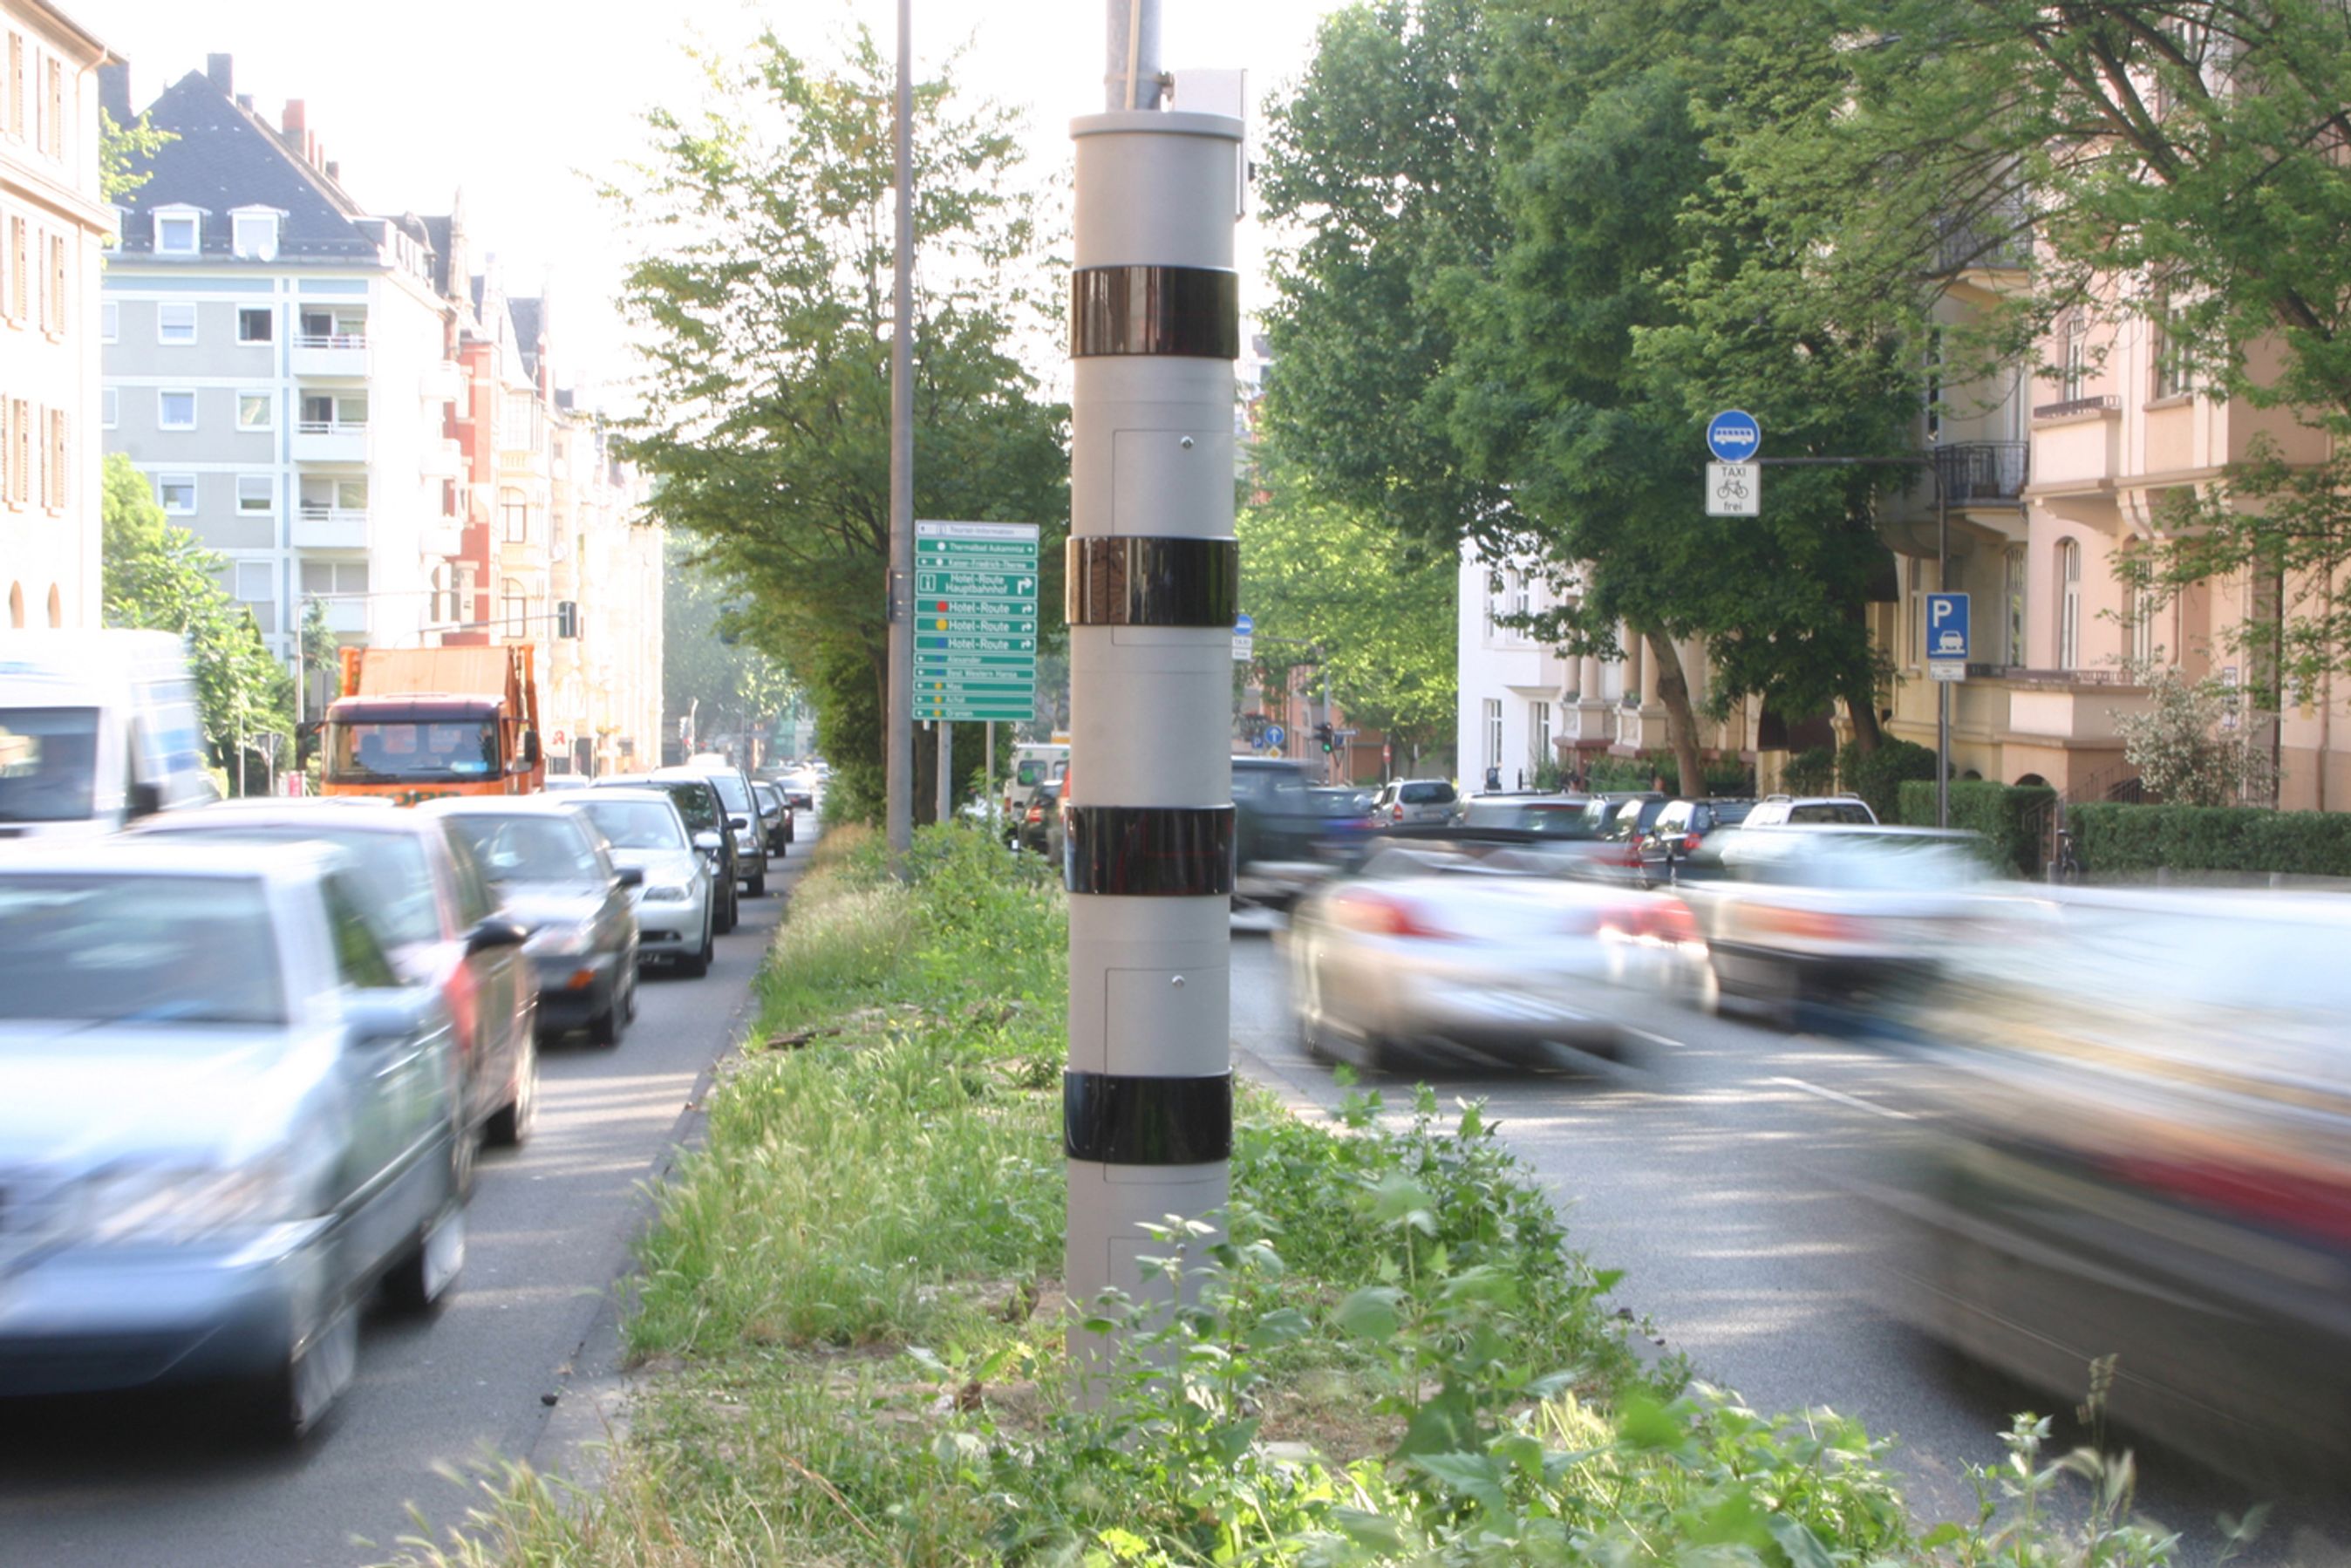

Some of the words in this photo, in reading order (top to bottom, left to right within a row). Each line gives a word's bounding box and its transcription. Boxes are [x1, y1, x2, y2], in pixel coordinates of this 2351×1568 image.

[1721, 467, 1747, 477] TAXI
[1723, 501, 1742, 511] frei
[950, 573, 1005, 584] Hotel-Route
[945, 583, 1008, 596] Hauptbahnhof
[948, 602, 1011, 615] Hotel-Route
[1932, 599, 1952, 628] P
[948, 619, 1011, 632] Hotel-Route
[947, 637, 1010, 651] Hotel-Route
